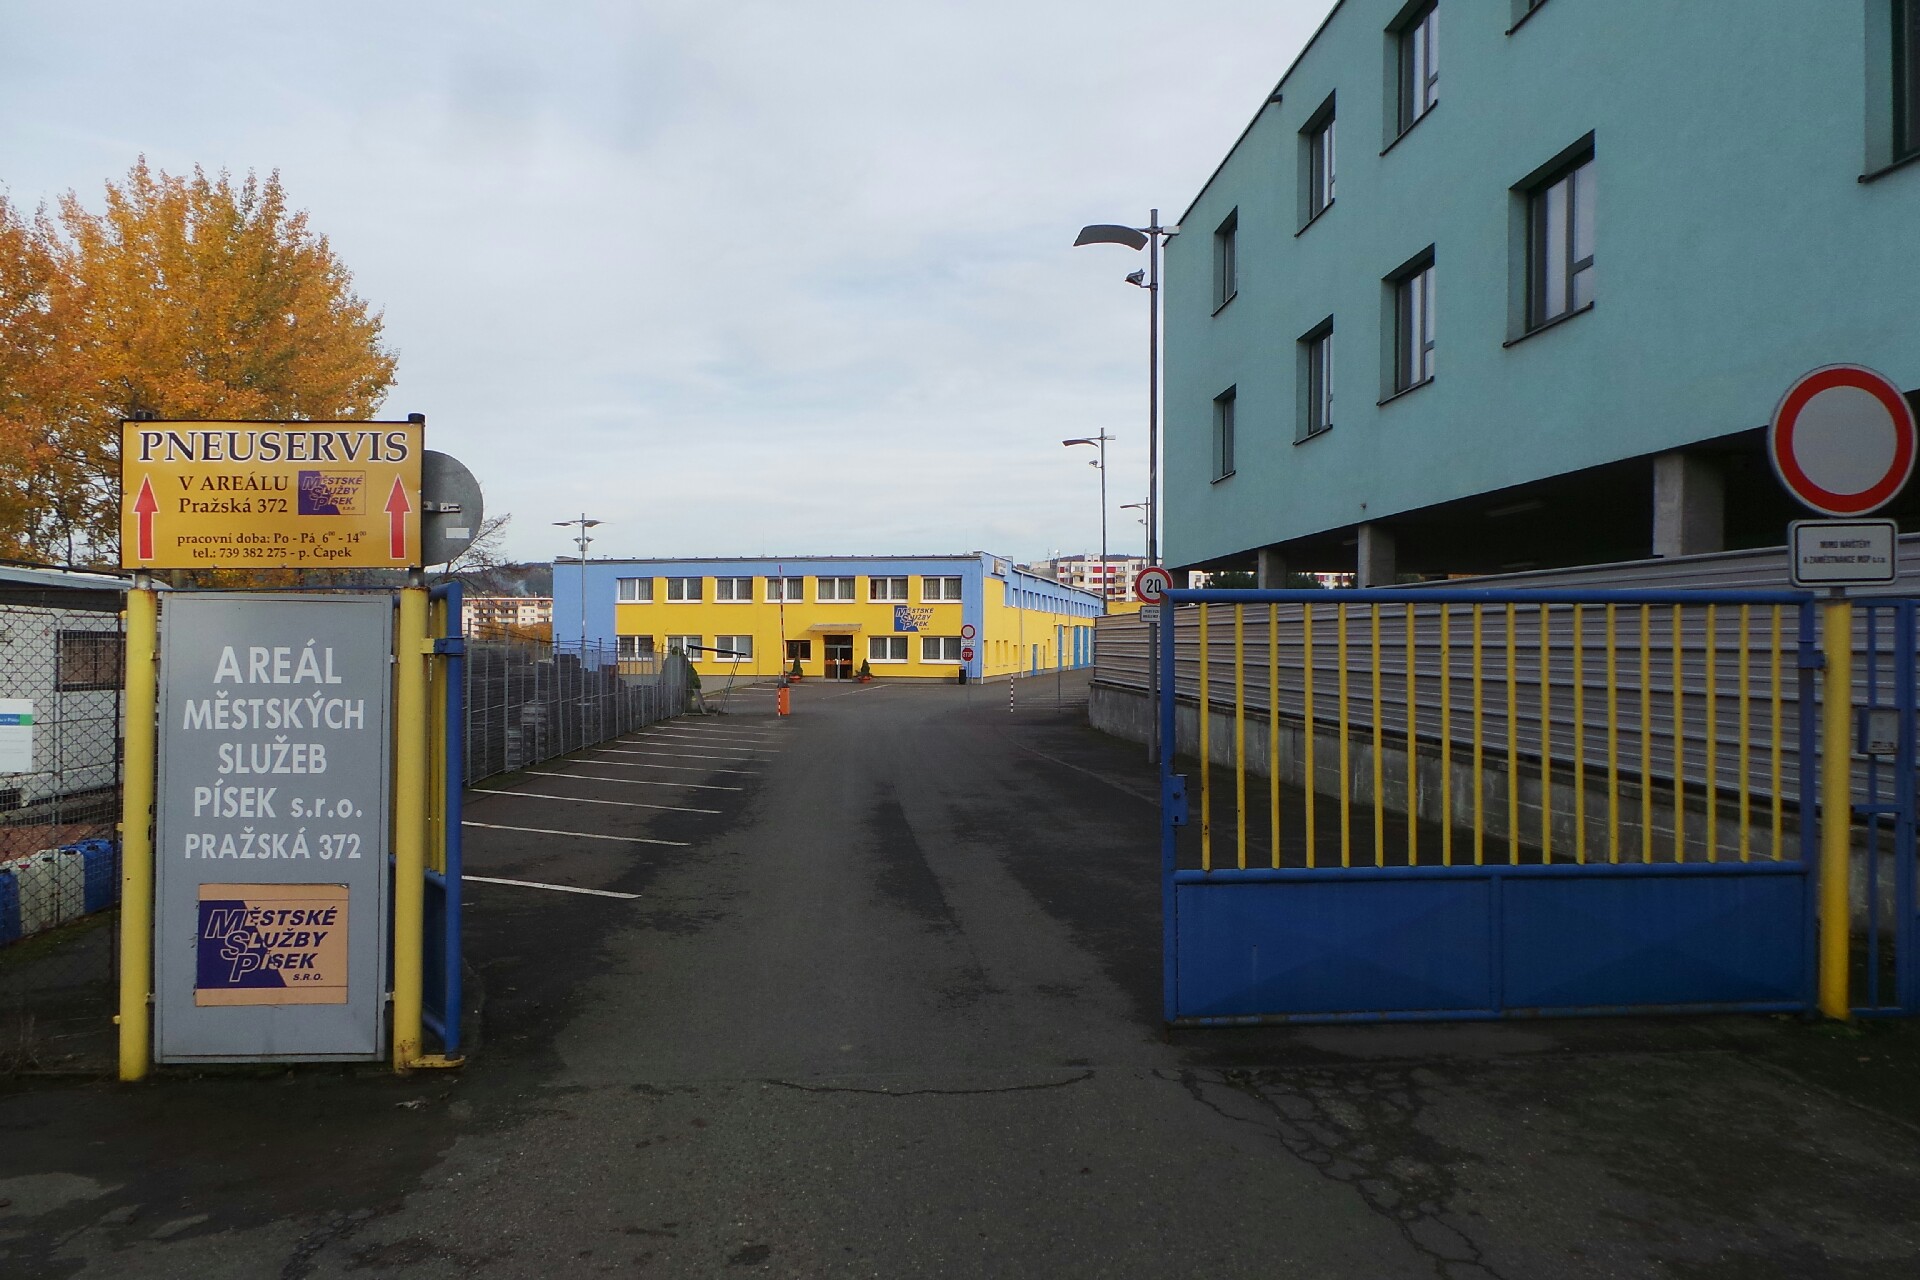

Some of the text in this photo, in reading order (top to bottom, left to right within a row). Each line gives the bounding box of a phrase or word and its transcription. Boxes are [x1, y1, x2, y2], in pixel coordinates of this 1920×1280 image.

[138, 430, 410, 463] PNEUSERVIS
[178, 471, 289, 491] V AREÁLU
[178, 498, 288, 513] Pražská 372
[177, 533, 232, 546] pracovní
[236, 532, 270, 544] doba:
[273, 533, 289, 544] Po
[301, 532, 315, 544] Pá
[193, 548, 216, 558] tel.:
[219, 548, 239, 558] 739
[242, 548, 263, 558] 382
[267, 548, 286, 558] 275
[313, 545, 352, 560] Čapek
[1146, 578, 1161, 593] 20
[213, 638, 342, 684] AREÁL
[183, 691, 364, 730] MĚSTSKÝCH
[217, 734, 327, 774] SLUŽEB
[194, 778, 362, 818] PÍSEK s.r.o.
[185, 826, 361, 859] PRAŽSKÁ 372
[204, 906, 338, 939] MĚSTSKÉ
[220, 928, 328, 960] SLUŽBY
[229, 949, 319, 983] PÍSEK
